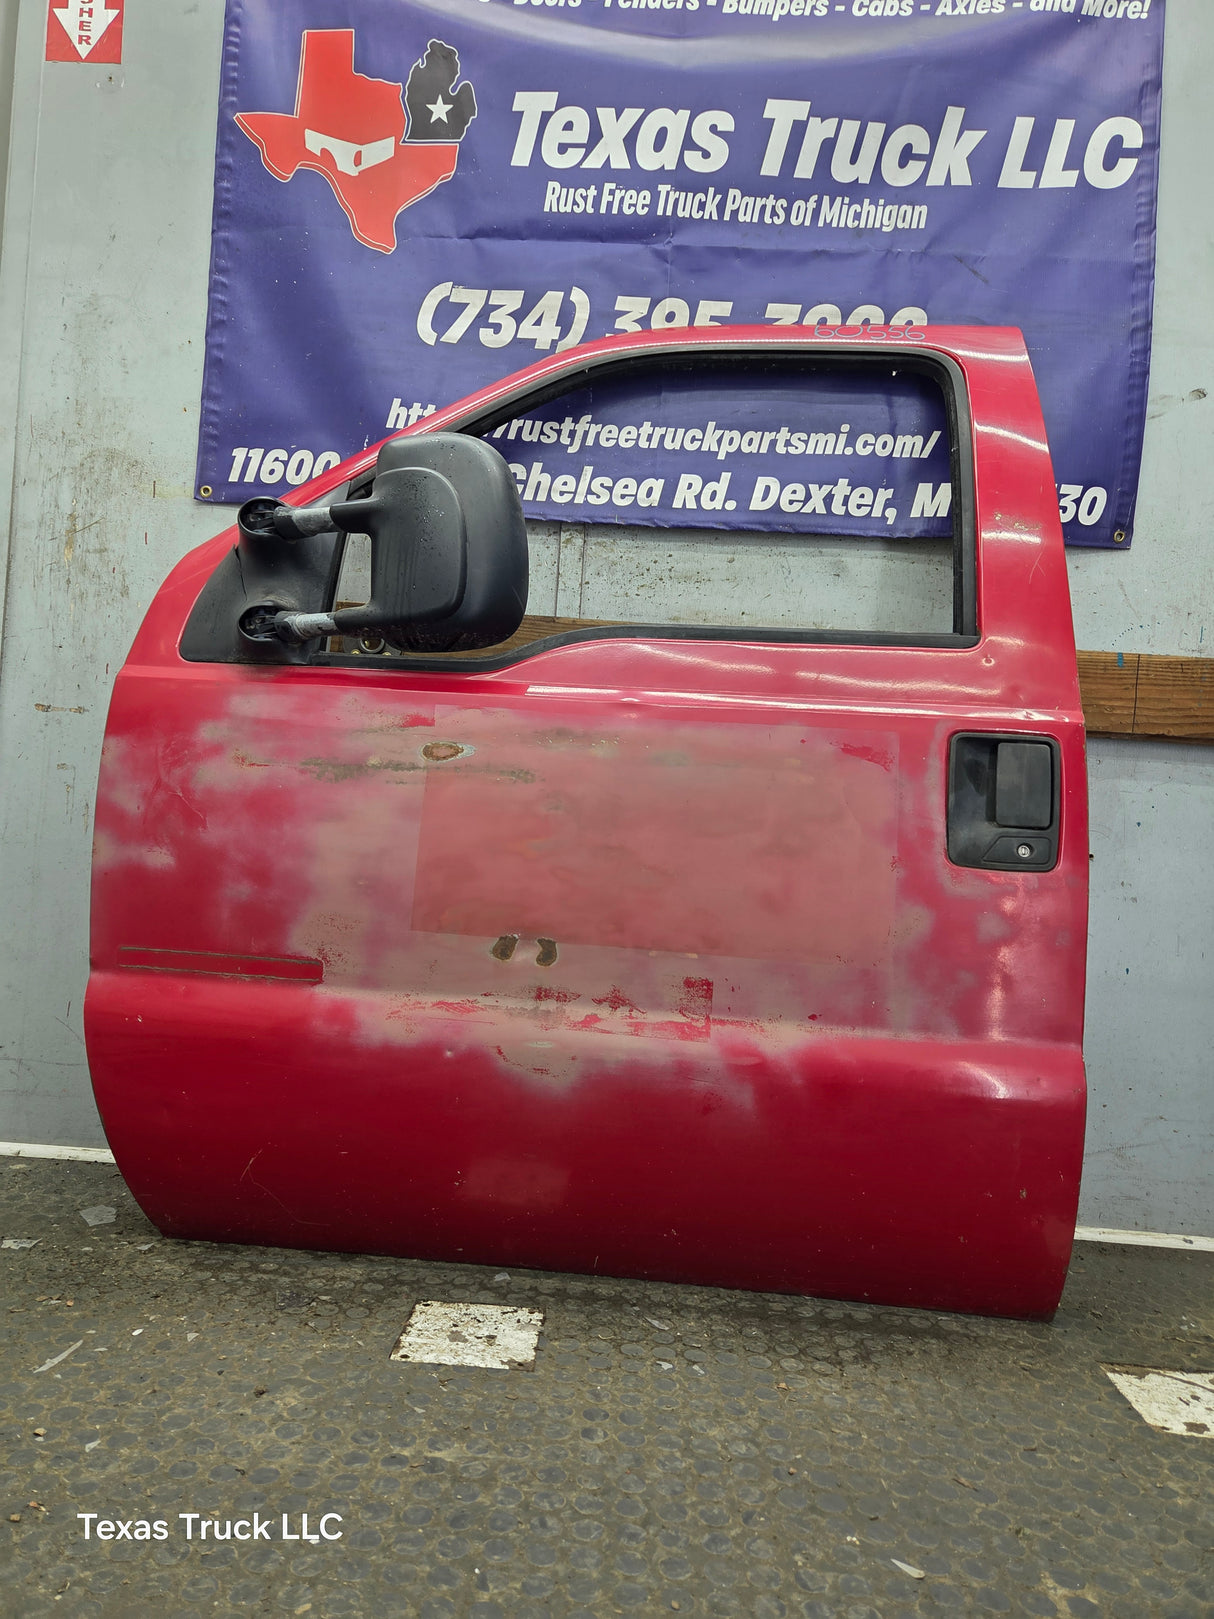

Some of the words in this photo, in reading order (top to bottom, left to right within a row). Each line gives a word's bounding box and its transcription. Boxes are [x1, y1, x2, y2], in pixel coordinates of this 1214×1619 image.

[722, 0, 829, 21] Bumpers
[852, 0, 913, 17] Cabs
[935, 0, 1005, 16] Axles
[1081, 0, 1150, 19] More!
[510, 91, 735, 173] Texas
[759, 98, 988, 187] Truck
[997, 116, 1144, 190] LLC
[543, 181, 597, 214] Rust
[599, 182, 652, 216] Free
[656, 184, 722, 221] Truck
[723, 188, 788, 225] Parts
[790, 194, 818, 227] of
[817, 195, 928, 232] Michigan
[416, 282, 590, 352] (734)
[814, 324, 926, 340] 60556
[228, 447, 342, 485] 11600
[671, 471, 737, 511] Rd.
[748, 476, 898, 525] Dexter,
[1055, 484, 1108, 526] 30
